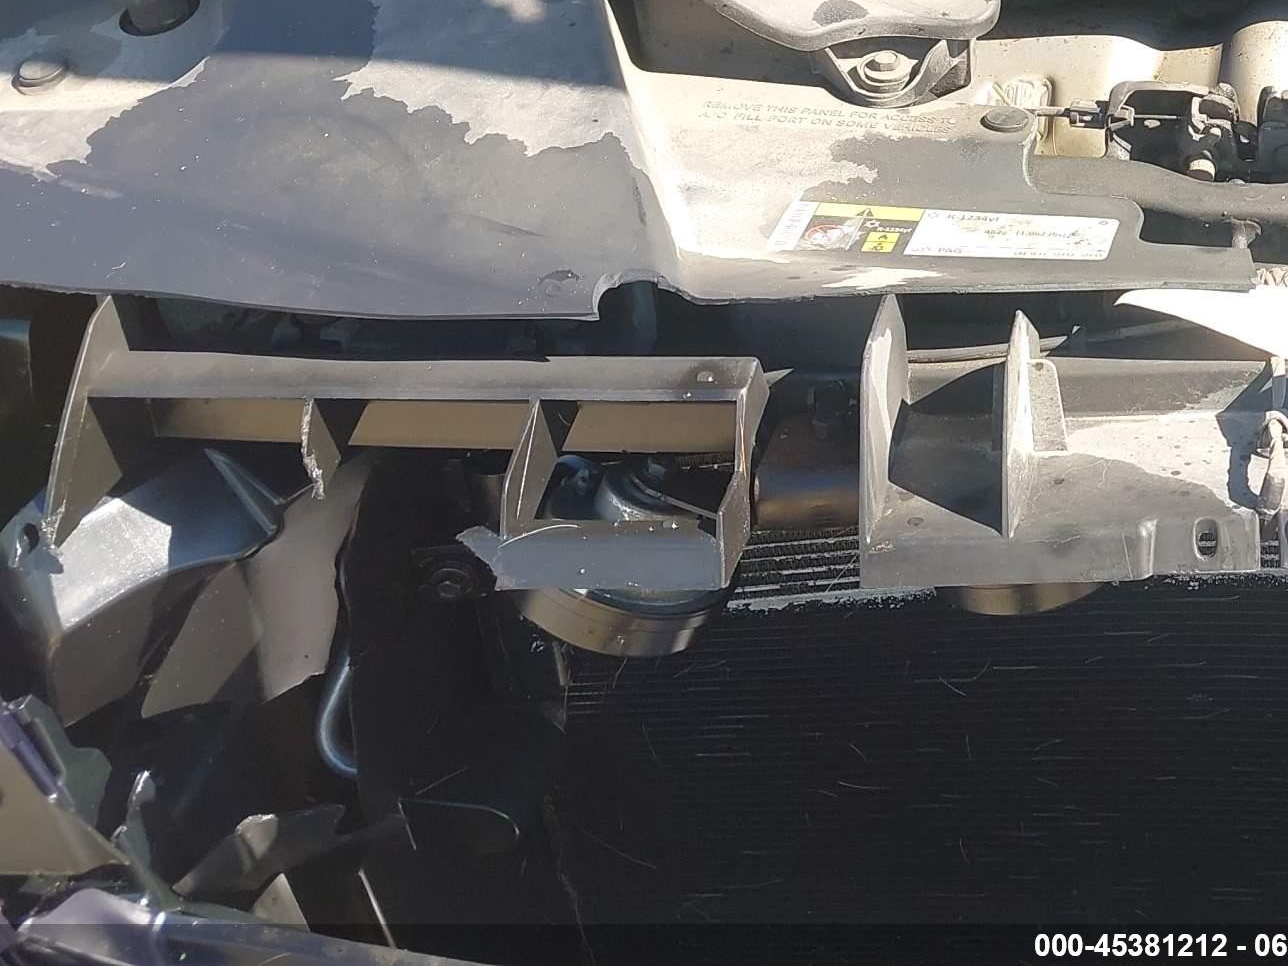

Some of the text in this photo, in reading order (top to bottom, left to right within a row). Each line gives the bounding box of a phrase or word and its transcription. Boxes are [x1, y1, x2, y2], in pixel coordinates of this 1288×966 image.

[703, 100, 957, 125] REMOVE THIS PANEL FOR ACCESS TO
[733, 112, 763, 122] FILL
[767, 115, 808, 124] PORT
[810, 117, 833, 126] ON
[836, 119, 879, 129] SOME
[884, 122, 952, 133] VEHICLES
